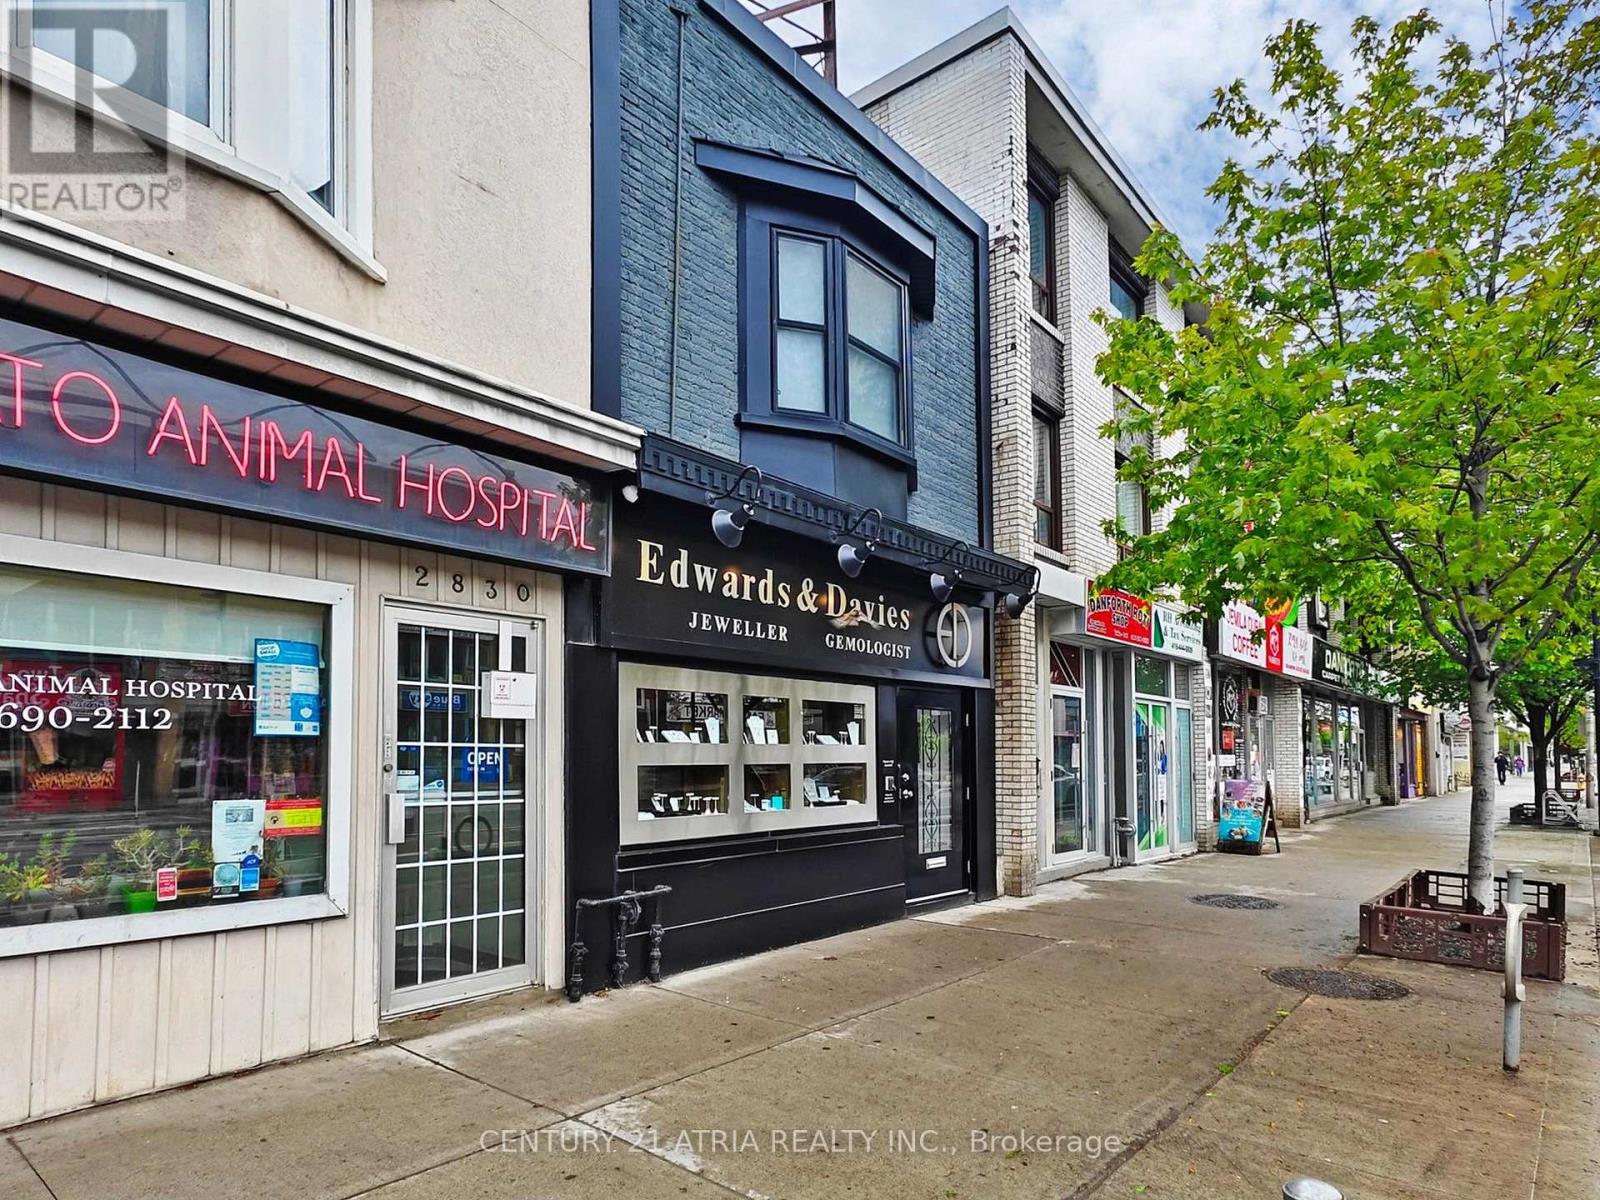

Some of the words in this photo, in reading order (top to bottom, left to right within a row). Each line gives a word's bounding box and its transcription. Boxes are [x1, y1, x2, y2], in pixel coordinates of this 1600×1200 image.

[0, 351, 121, 444] TO
[148, 396, 382, 503] ANIMAL
[398, 454, 597, 551] HOSPITAL
[414, 565, 531, 602] 2830
[636, 538, 792, 609] Edwards
[796, 577, 819, 613] &
[825, 582, 911, 630] Davies
[688, 611, 789, 642] JEWELLER
[824, 633, 912, 660] GEMOLOGIST
[125, 679, 262, 701] HOSPITAL
